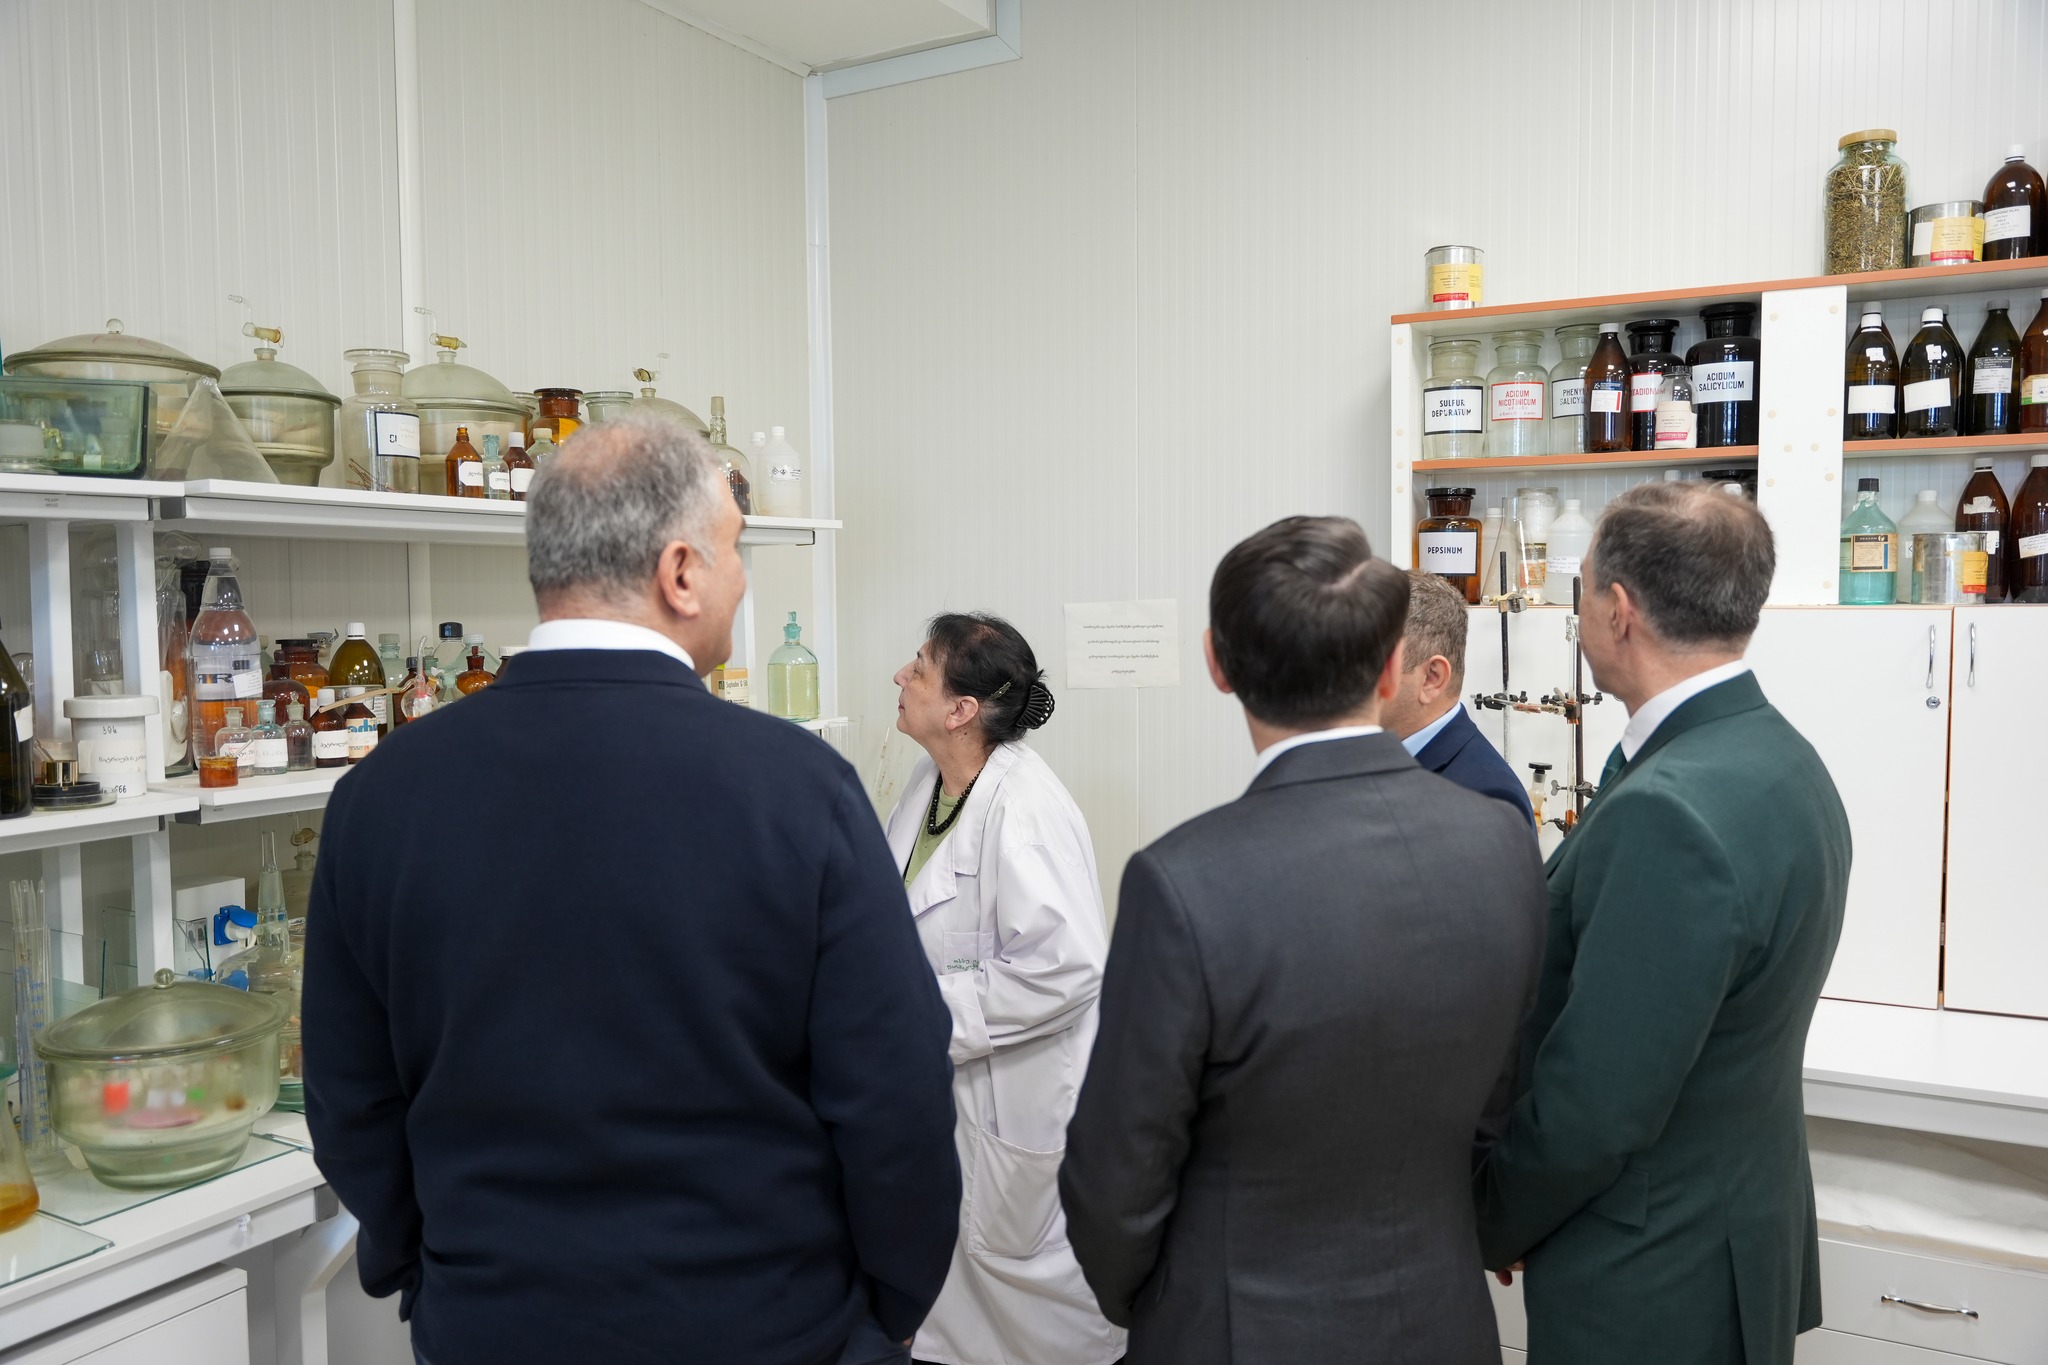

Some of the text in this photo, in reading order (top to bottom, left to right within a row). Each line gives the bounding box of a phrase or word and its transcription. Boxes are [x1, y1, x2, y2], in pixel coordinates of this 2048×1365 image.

[1706, 371, 1736, 382] ACIDUM
[1698, 380, 1745, 392] SALICYLICUM
[1505, 390, 1530, 398] ACIDUM
[1439, 399, 1466, 407] SULFUR
[1498, 398, 1537, 407] NICOTINICUM
[1431, 408, 1472, 418] DEPURATUM
[1427, 546, 1463, 554] PEPSINUM
